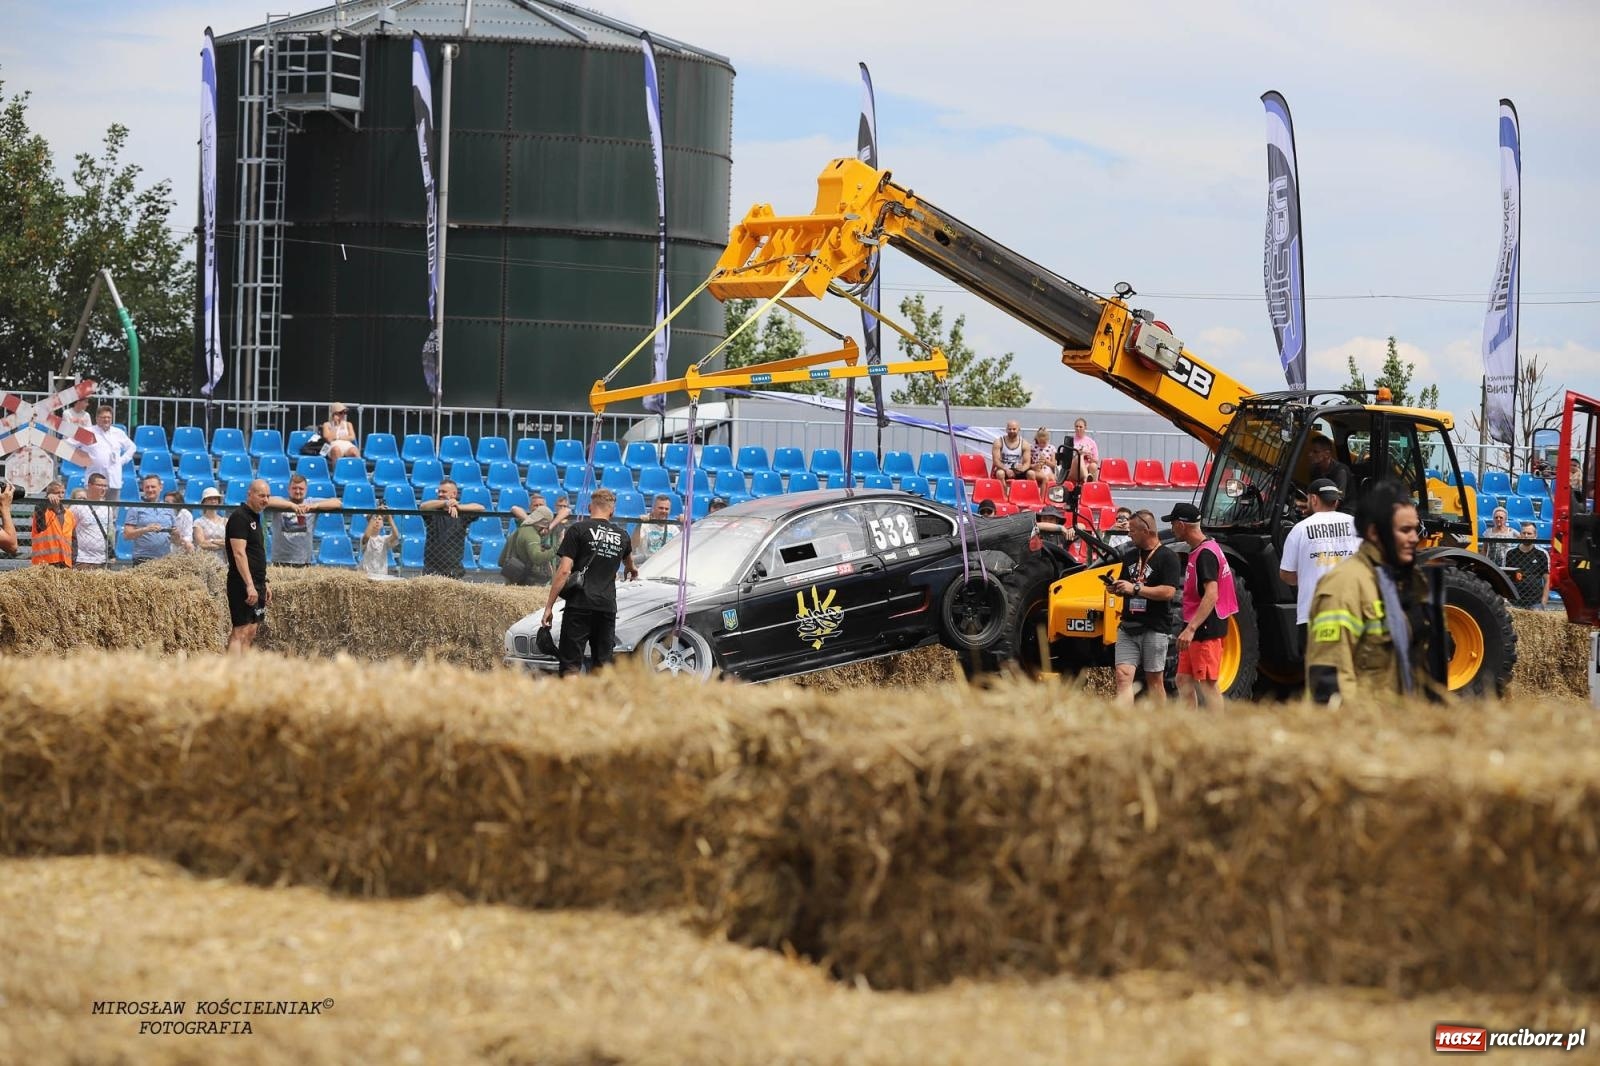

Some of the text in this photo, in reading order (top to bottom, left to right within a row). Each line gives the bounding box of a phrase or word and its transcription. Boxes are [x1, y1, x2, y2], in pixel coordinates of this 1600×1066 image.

[1167, 357, 1212, 396] CB
[589, 527, 622, 546] VANS
[869, 514, 915, 550] 532
[1306, 522, 1352, 540] UKRAINE
[1067, 619, 1095, 632] JCB
